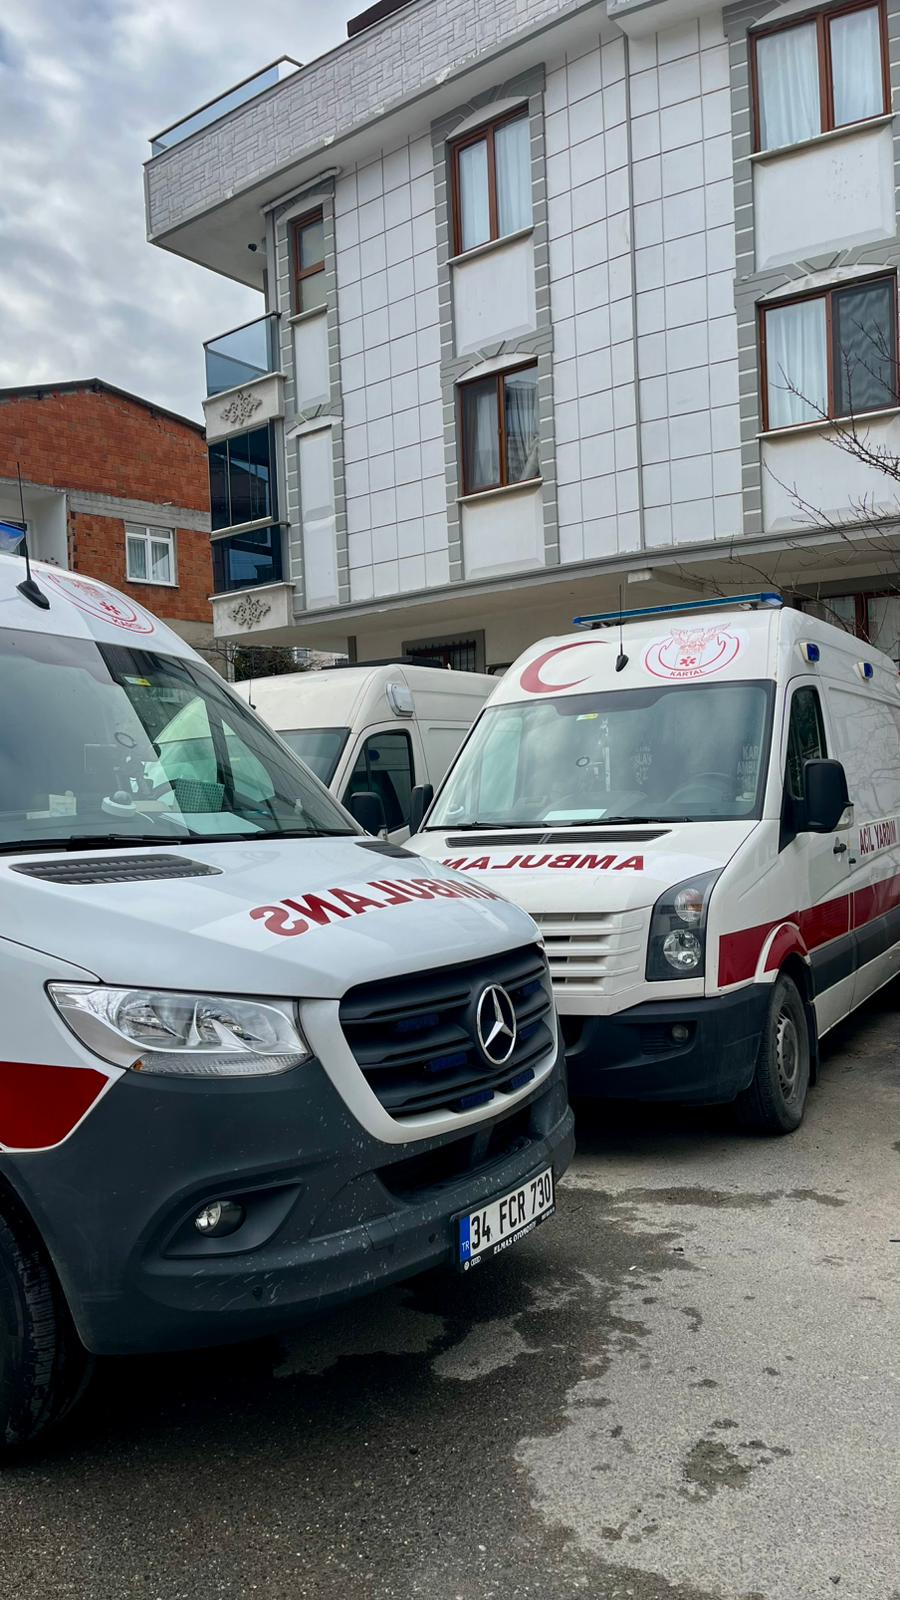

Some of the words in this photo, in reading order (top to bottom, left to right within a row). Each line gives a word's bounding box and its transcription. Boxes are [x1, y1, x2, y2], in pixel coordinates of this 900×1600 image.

[670, 668, 704, 677] KARTAL
[471, 1211, 491, 1250] 34
[499, 1190, 526, 1235] FCR
[530, 1173, 551, 1214] 730
[462, 1240, 470, 1252] TR
[493, 1237, 513, 1255] ELMAS
